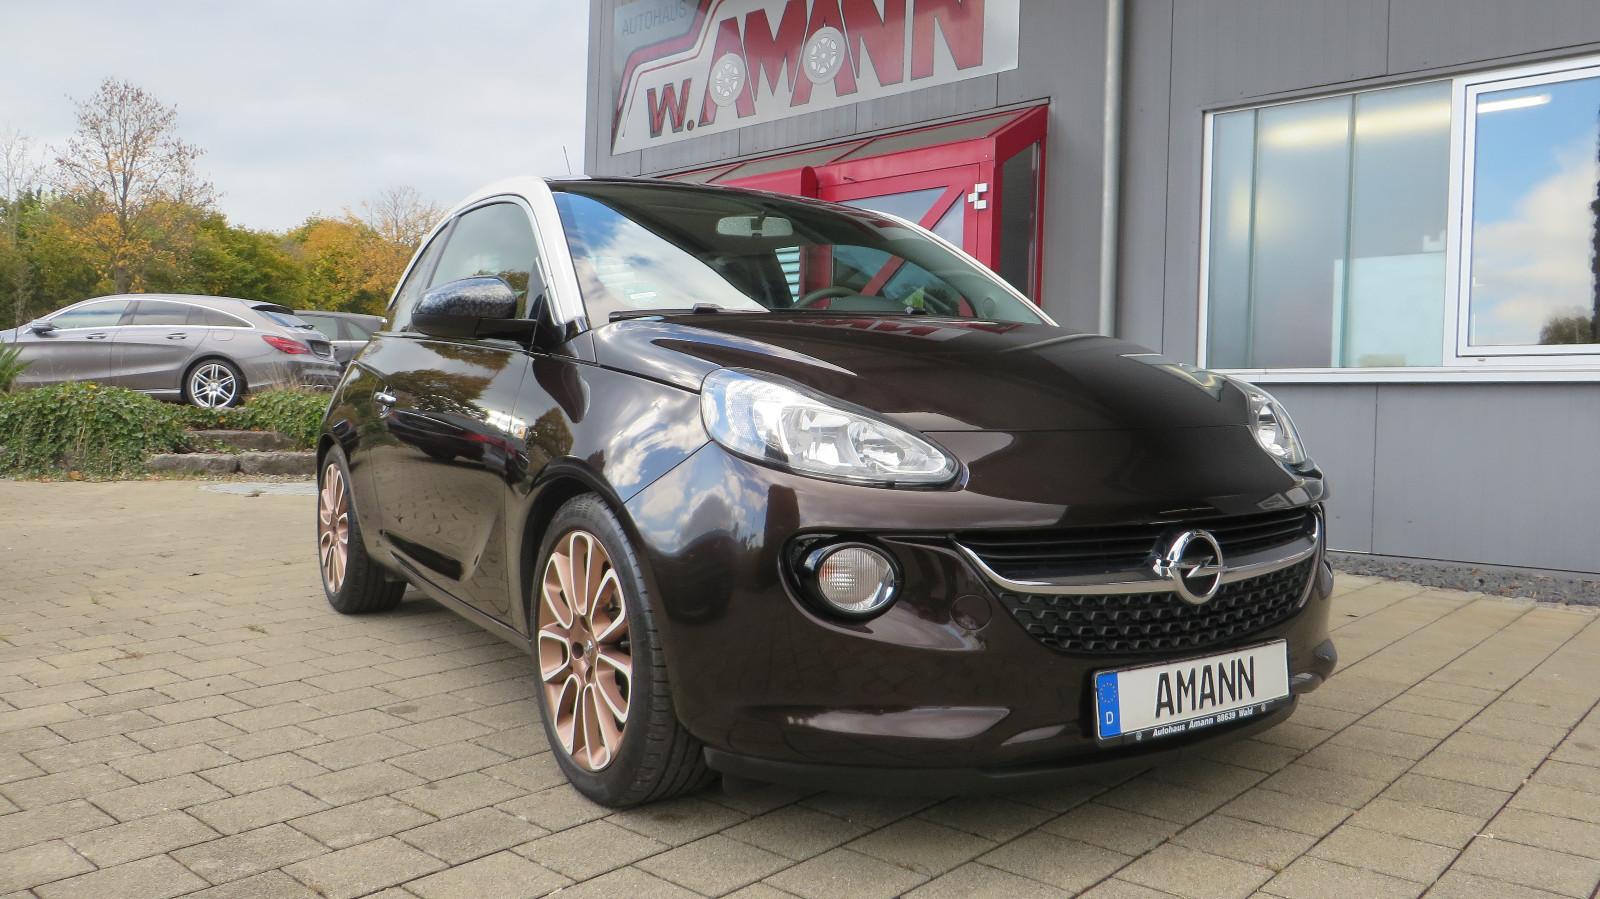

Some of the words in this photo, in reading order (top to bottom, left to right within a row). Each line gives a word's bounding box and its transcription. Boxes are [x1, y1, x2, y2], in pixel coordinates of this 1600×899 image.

[623, 4, 687, 36] AUTOHAUS
[1156, 656, 1254, 718] AMANN
[1105, 711, 1114, 725] D
[1153, 724, 1185, 737] Autohaus
[1189, 717, 1213, 729] Amann
[1216, 711, 1236, 723] 88639
[1239, 706, 1254, 717] Wald
